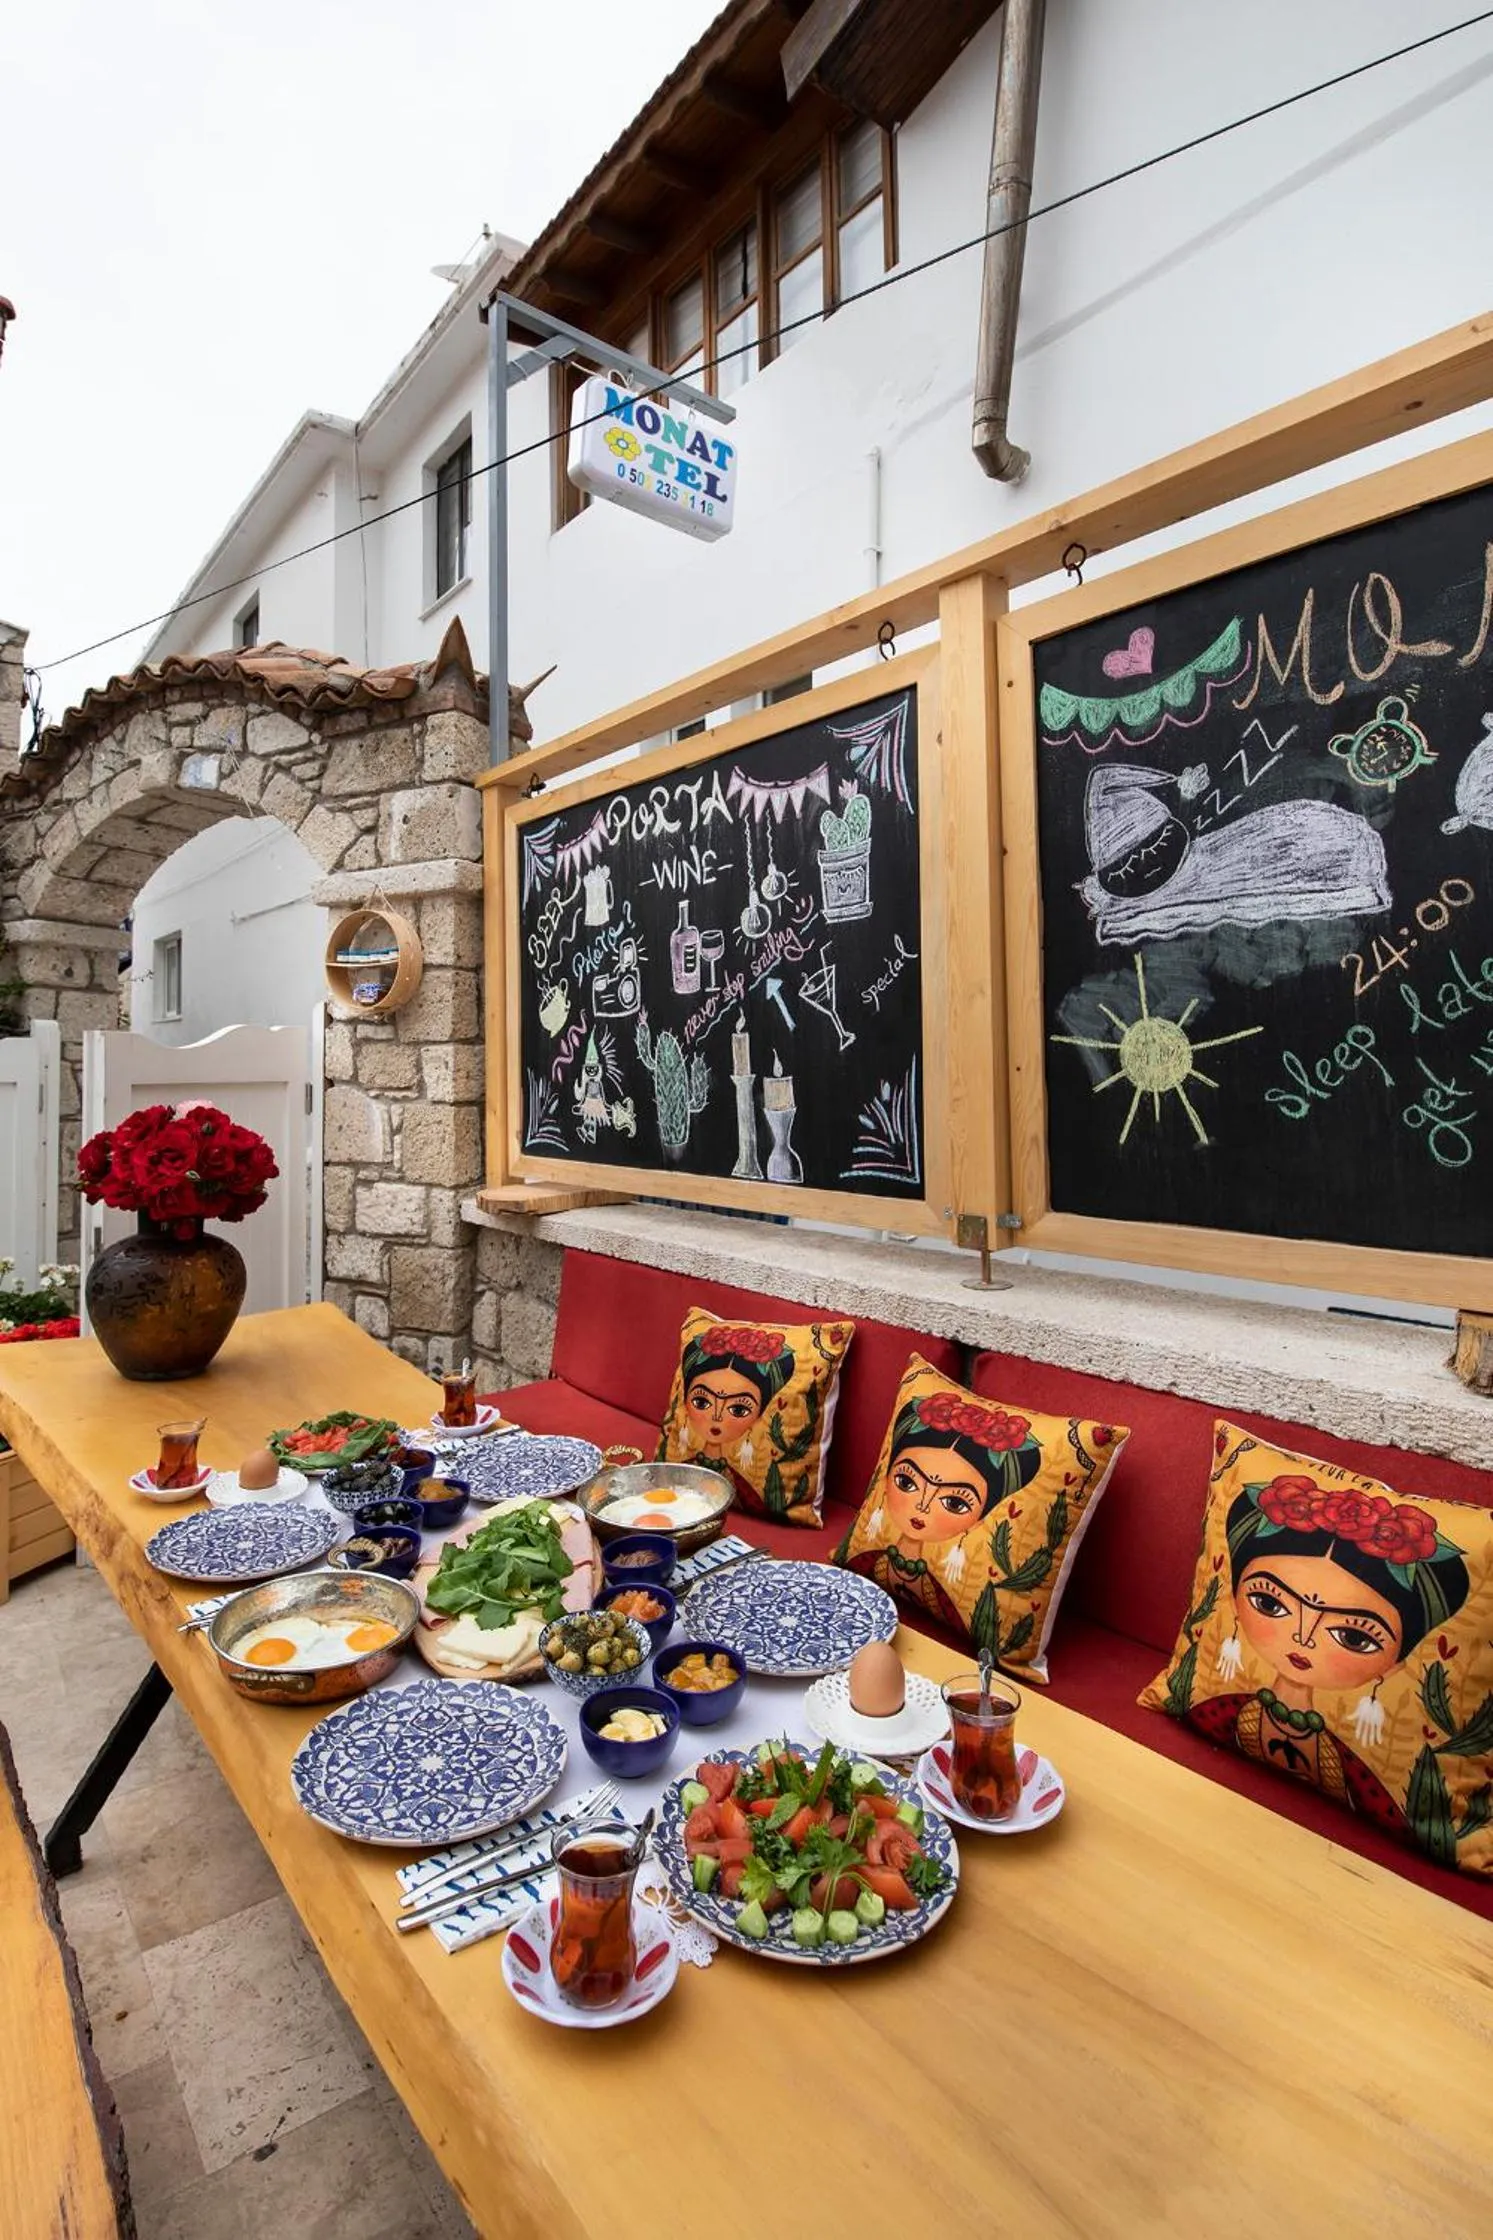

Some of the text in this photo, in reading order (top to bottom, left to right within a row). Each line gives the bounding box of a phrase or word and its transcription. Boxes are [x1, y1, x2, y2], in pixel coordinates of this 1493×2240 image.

[605, 386, 733, 471] MONAT
[645, 444, 728, 503] TEL
[1231, 541, 1493, 710] MO
[605, 770, 734, 846] PORTA
[528, 874, 582, 969] BEER
[1339, 878, 1475, 996] 24:00
[683, 926, 815, 1044] never stop smiling
[861, 933, 919, 1012] special
[1402, 1056, 1477, 1167] get
